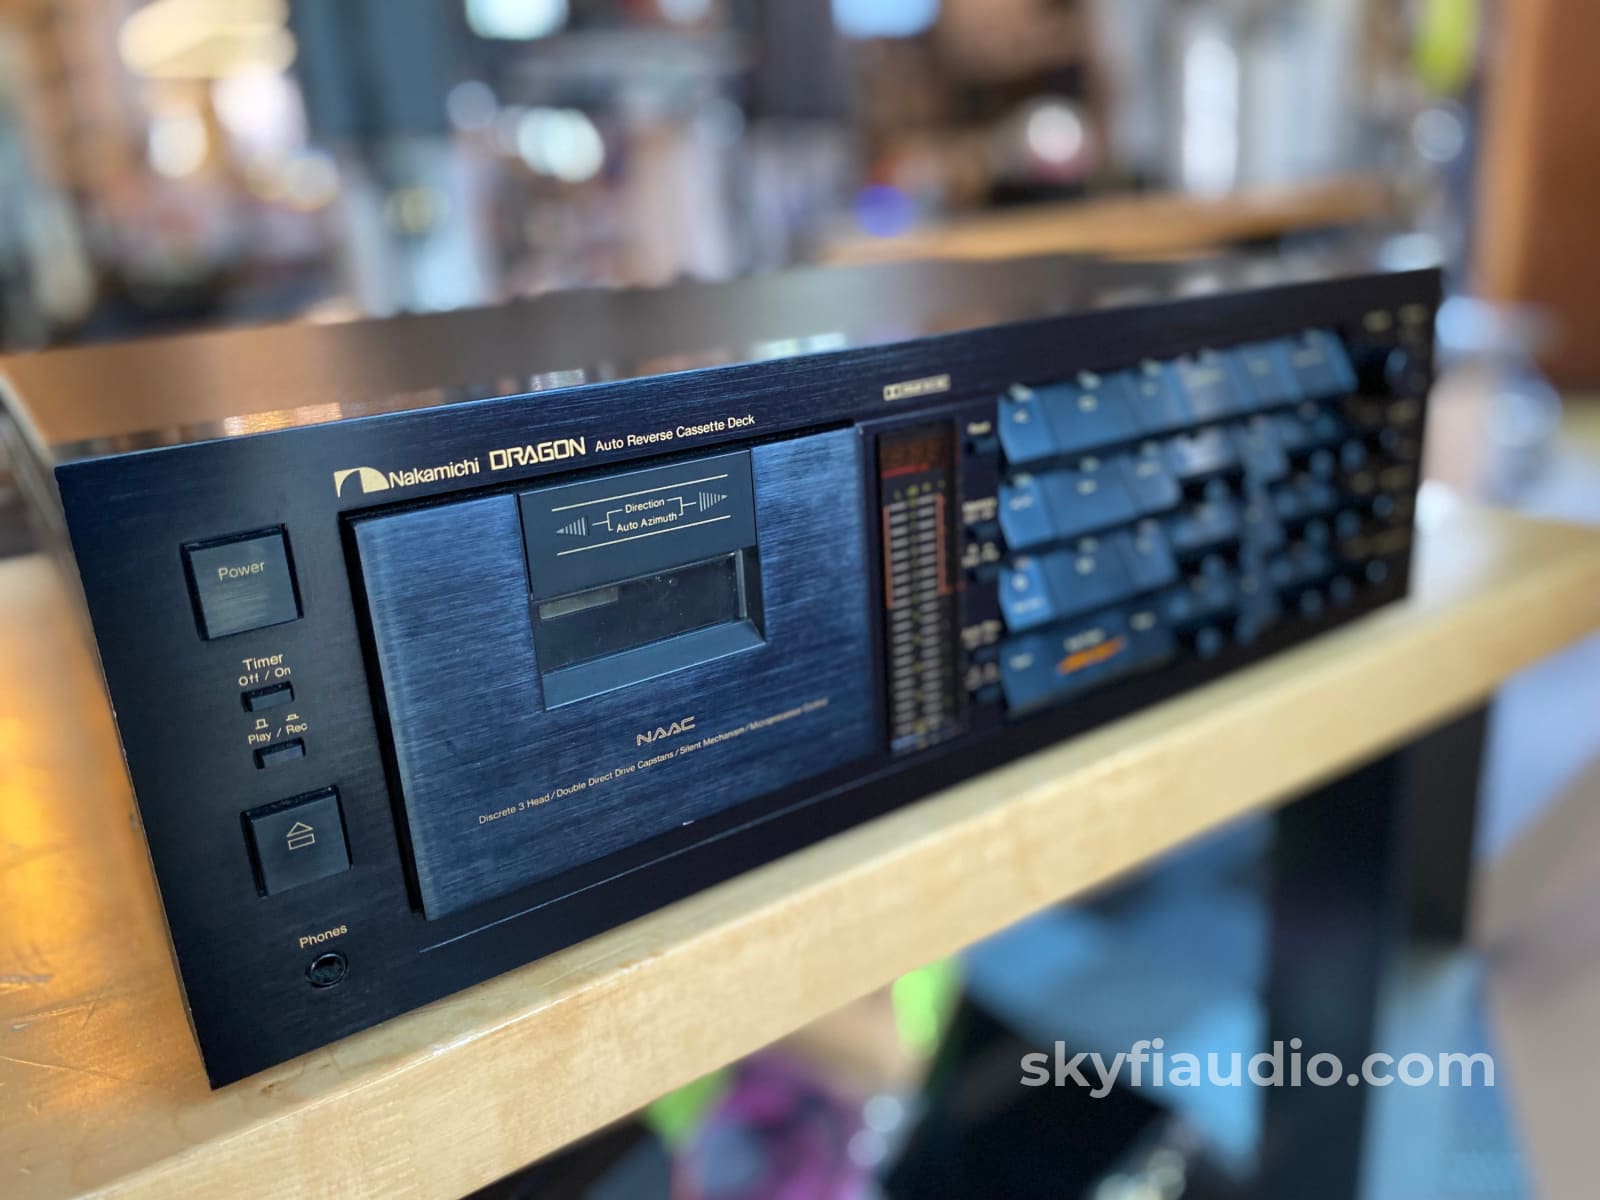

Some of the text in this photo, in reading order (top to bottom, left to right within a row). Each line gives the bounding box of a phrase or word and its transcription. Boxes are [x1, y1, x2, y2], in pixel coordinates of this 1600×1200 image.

[388, 414, 755, 488] Nakamichi DRAGON Auto Reverse Cassette Deck
[625, 499, 665, 514] Direction
[616, 512, 677, 533] Auto Azimuth
[218, 562, 265, 581] Power
[242, 653, 283, 671] Timer
[238, 673, 259, 686] Off
[275, 667, 291, 678] On
[248, 731, 272, 745] Play
[286, 722, 308, 735] Rec
[636, 715, 696, 747] NAAC
[478, 806, 516, 825] Discrete
[518, 802, 525, 811] 3
[588, 772, 613, 787] Direct
[614, 764, 635, 777] Drive
[299, 924, 348, 949] Phones
